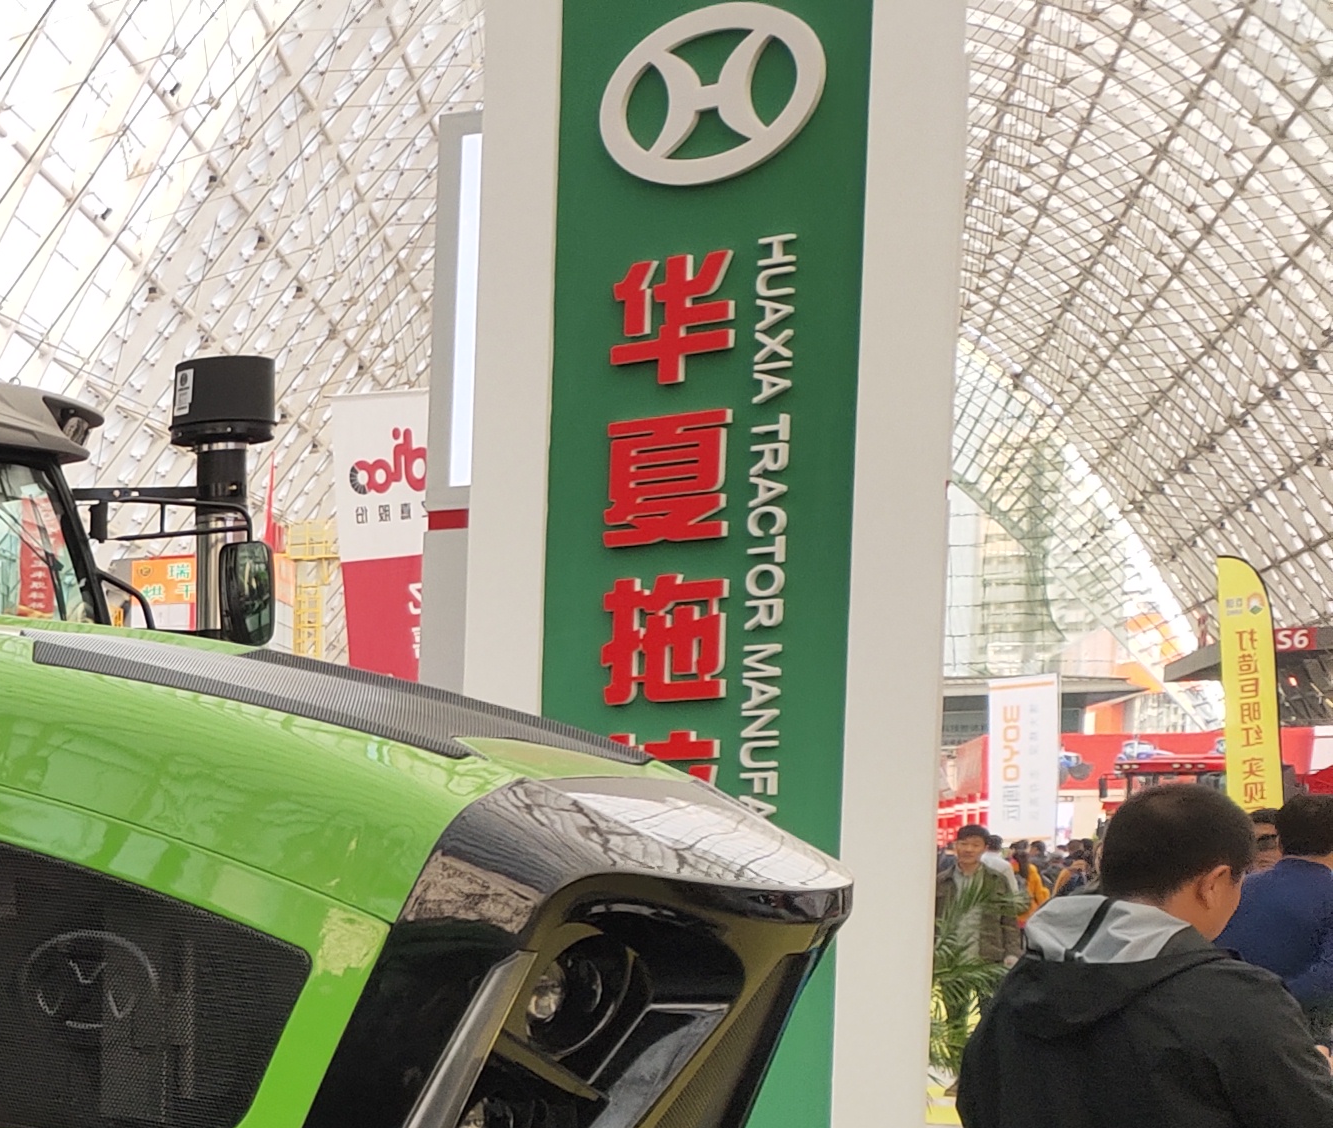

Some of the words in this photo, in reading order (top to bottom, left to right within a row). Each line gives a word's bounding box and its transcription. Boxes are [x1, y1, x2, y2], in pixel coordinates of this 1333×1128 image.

[752, 232, 798, 404] HUAXIA
[743, 413, 791, 630] TRACTOR
[1276, 629, 1310, 650] S6
